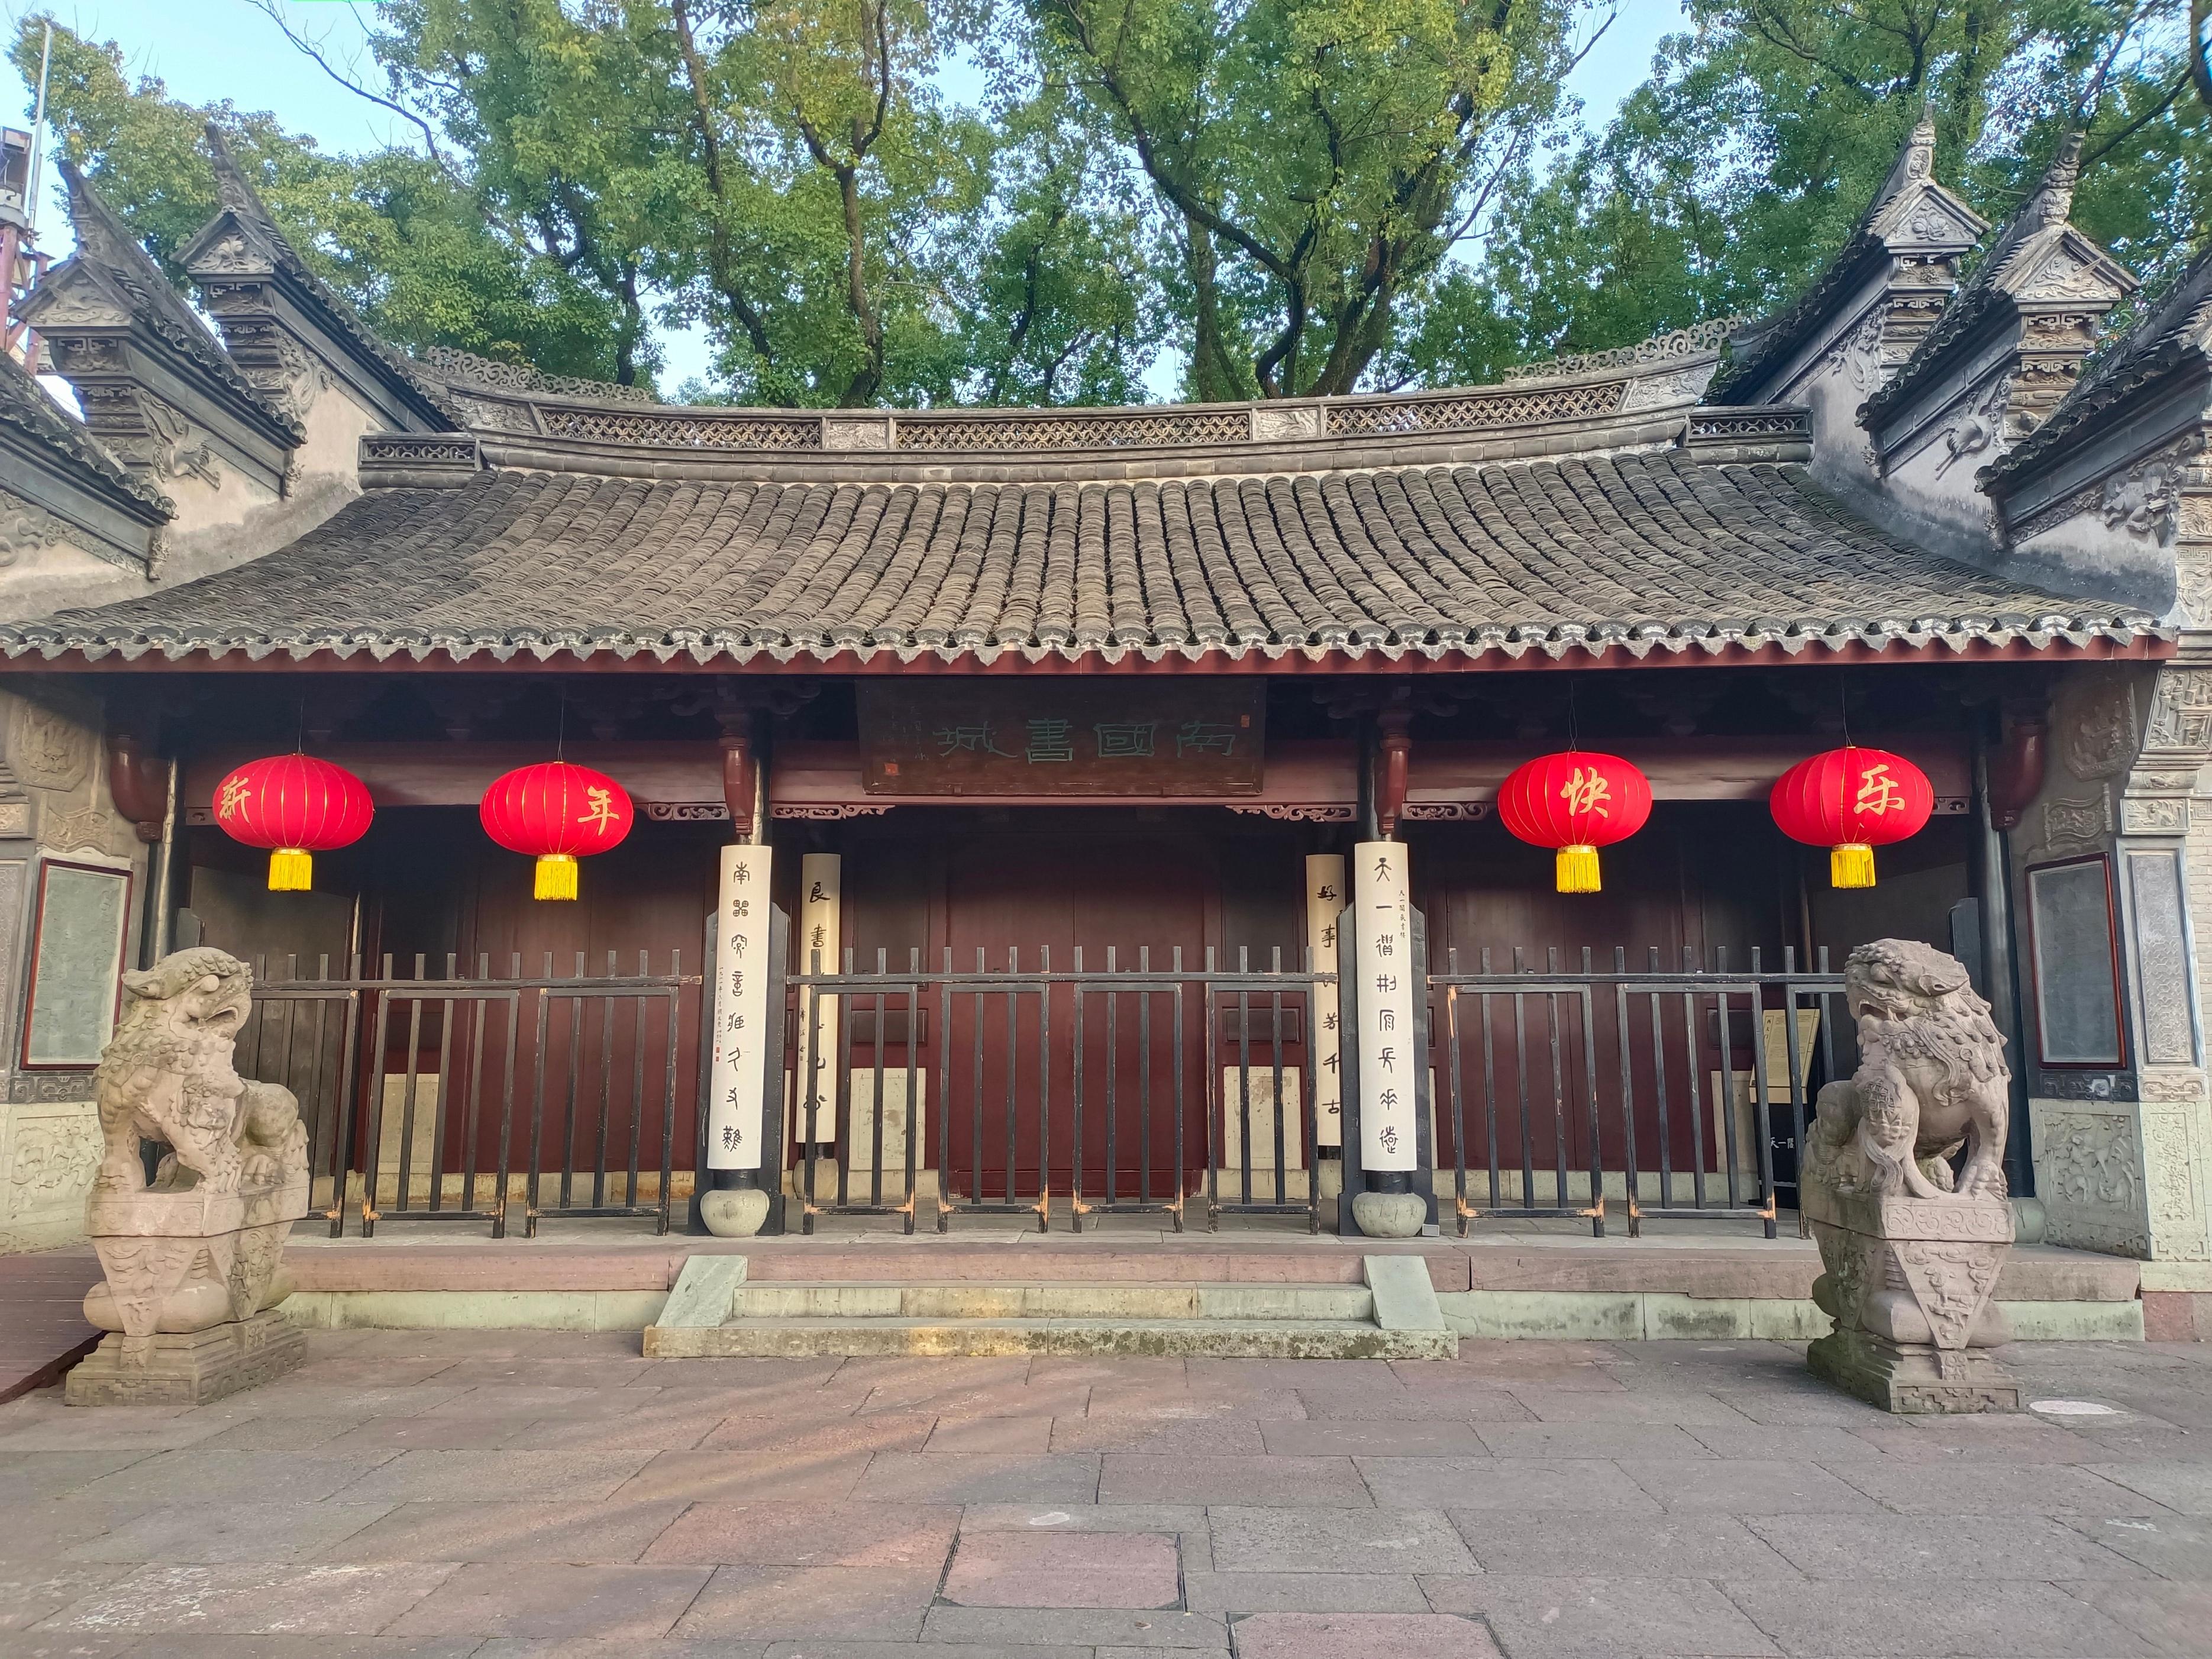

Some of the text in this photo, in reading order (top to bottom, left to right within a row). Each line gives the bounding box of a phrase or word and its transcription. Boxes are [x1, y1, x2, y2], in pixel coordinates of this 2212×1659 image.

[219, 776, 251, 822] 新
[577, 786, 619, 835] 年
[1560, 767, 1612, 818] 快
[1853, 764, 1906, 816] 乐
